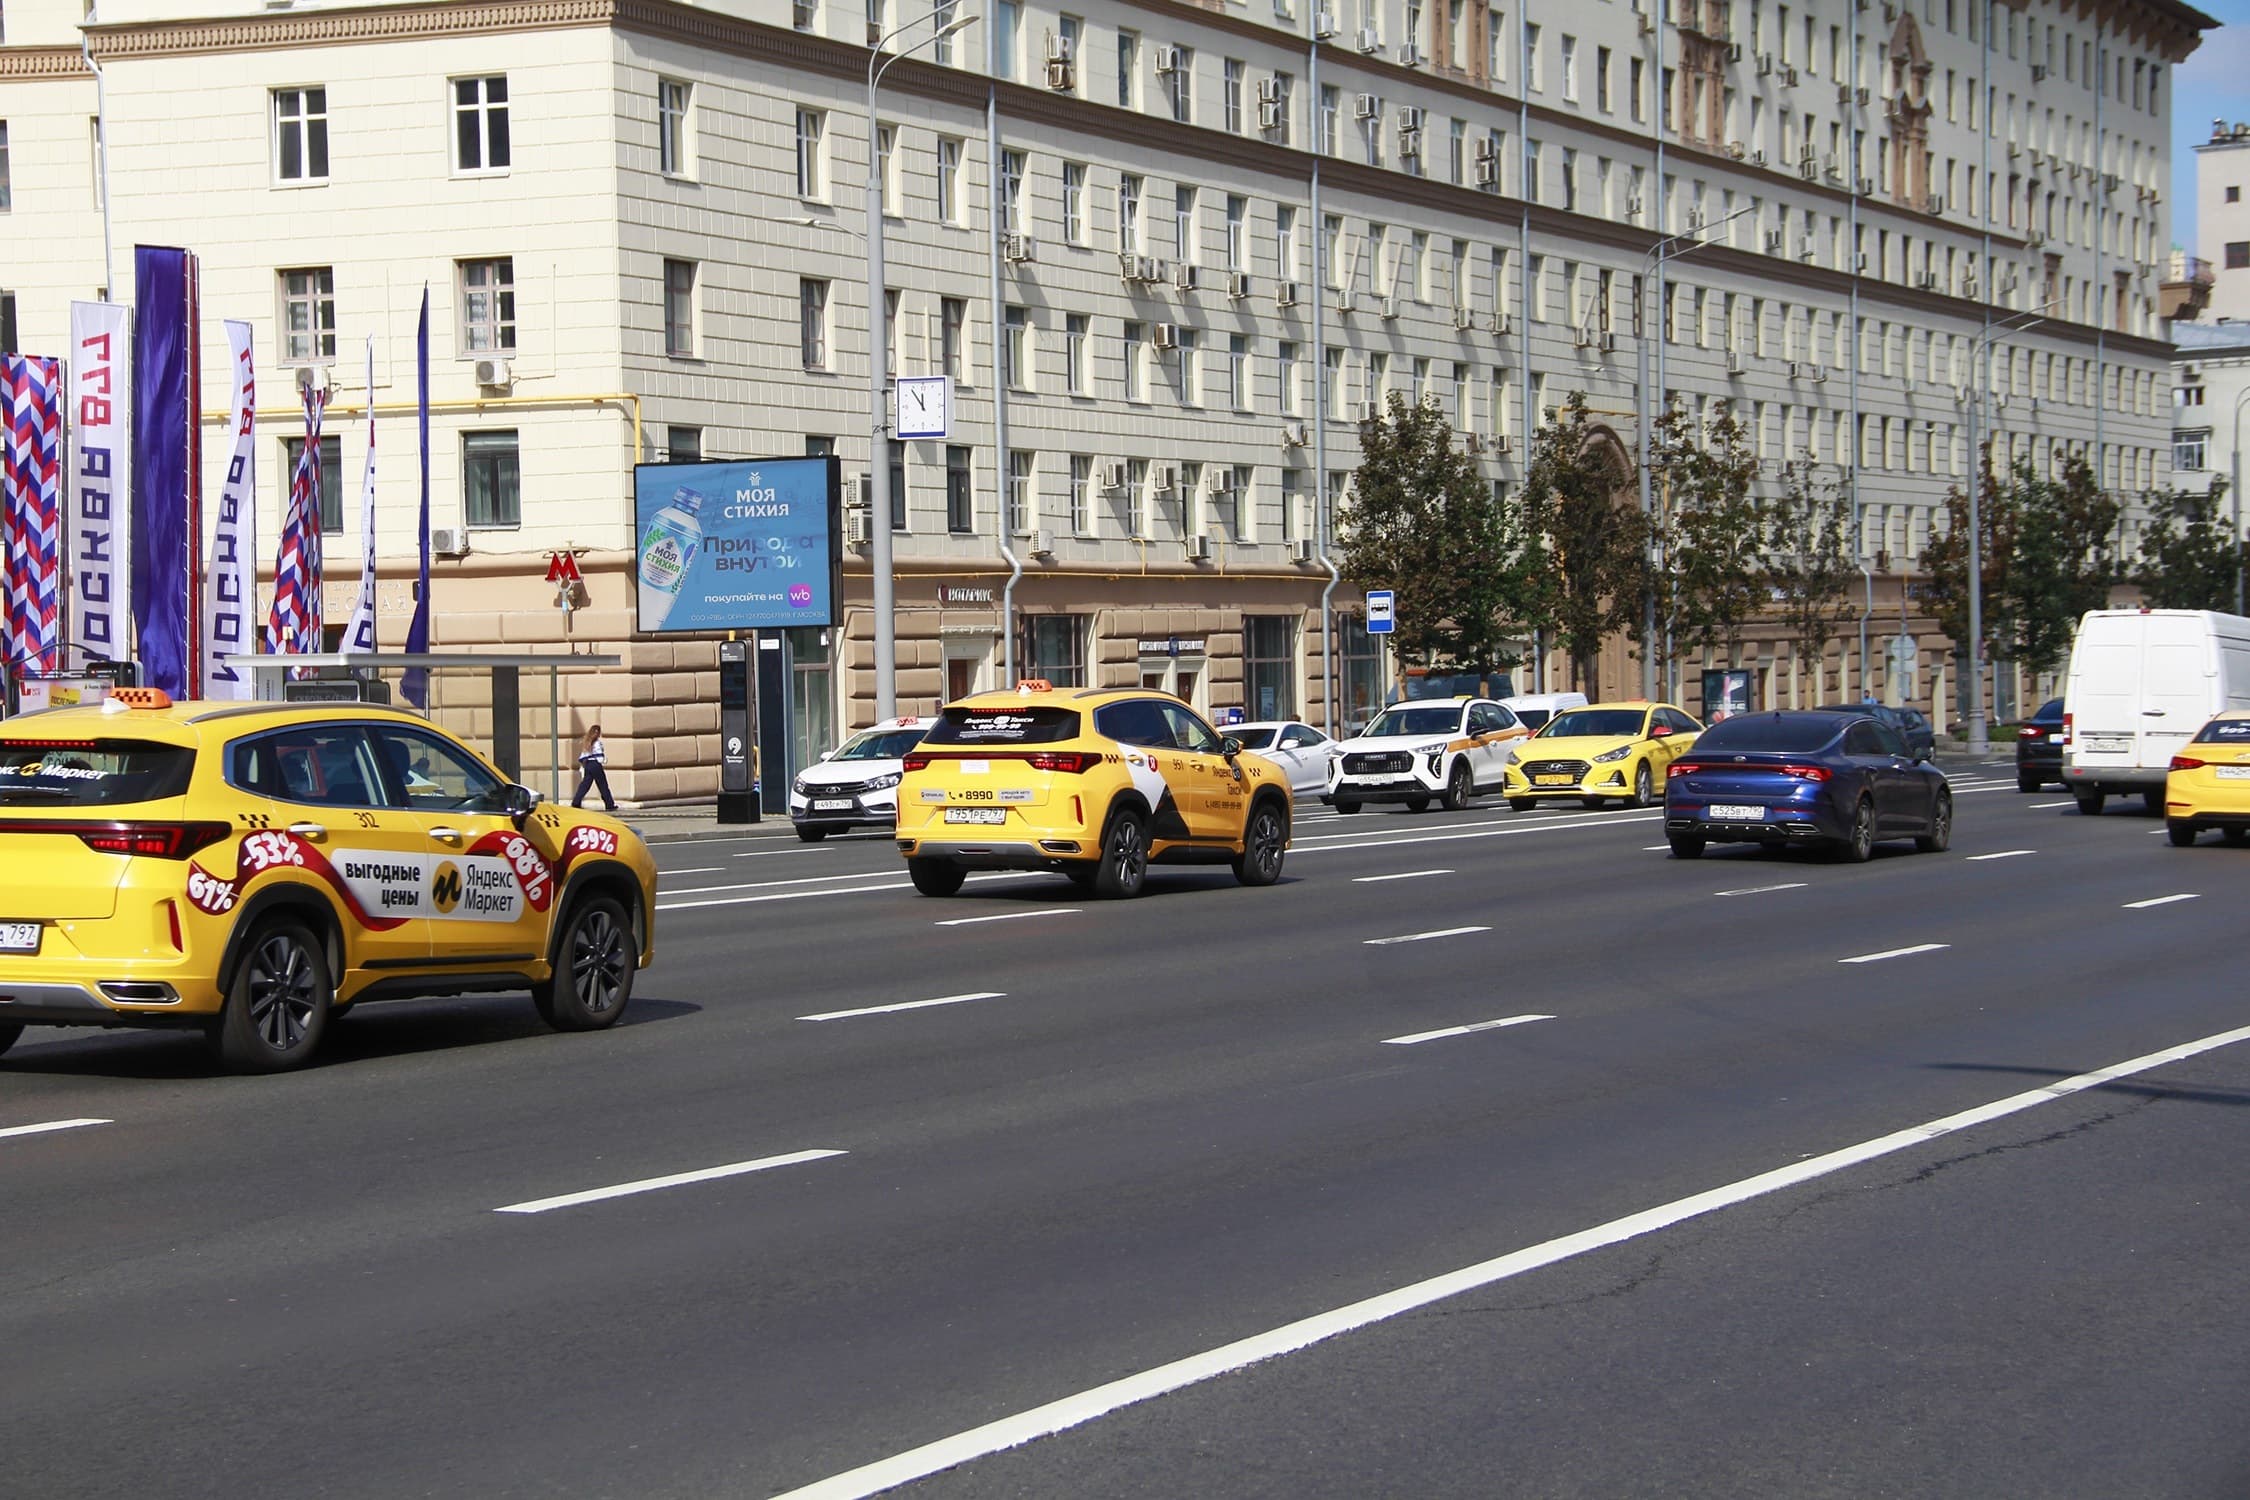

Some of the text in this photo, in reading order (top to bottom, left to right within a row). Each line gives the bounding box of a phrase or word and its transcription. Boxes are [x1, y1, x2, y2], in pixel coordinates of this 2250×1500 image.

[736, 488, 775, 503] МОЯ
[724, 504, 789, 519] СТИХИЯ
[645, 552, 681, 573] СТИХИЯ
[654, 546, 678, 562] МОЯ
[704, 591, 767, 604] покупайте
[769, 592, 784, 601] на
[41, 764, 109, 780] Маркет
[965, 790, 993, 800] 8990
[353, 812, 380, 828] 312
[571, 827, 614, 854] -59%
[242, 831, 304, 871] -53%
[345, 862, 421, 884] выгодные
[466, 863, 513, 888] Яндекс
[500, 836, 550, 901] -68%
[188, 872, 233, 911] 61%
[381, 889, 420, 909] цены
[464, 888, 514, 915] Маркет
